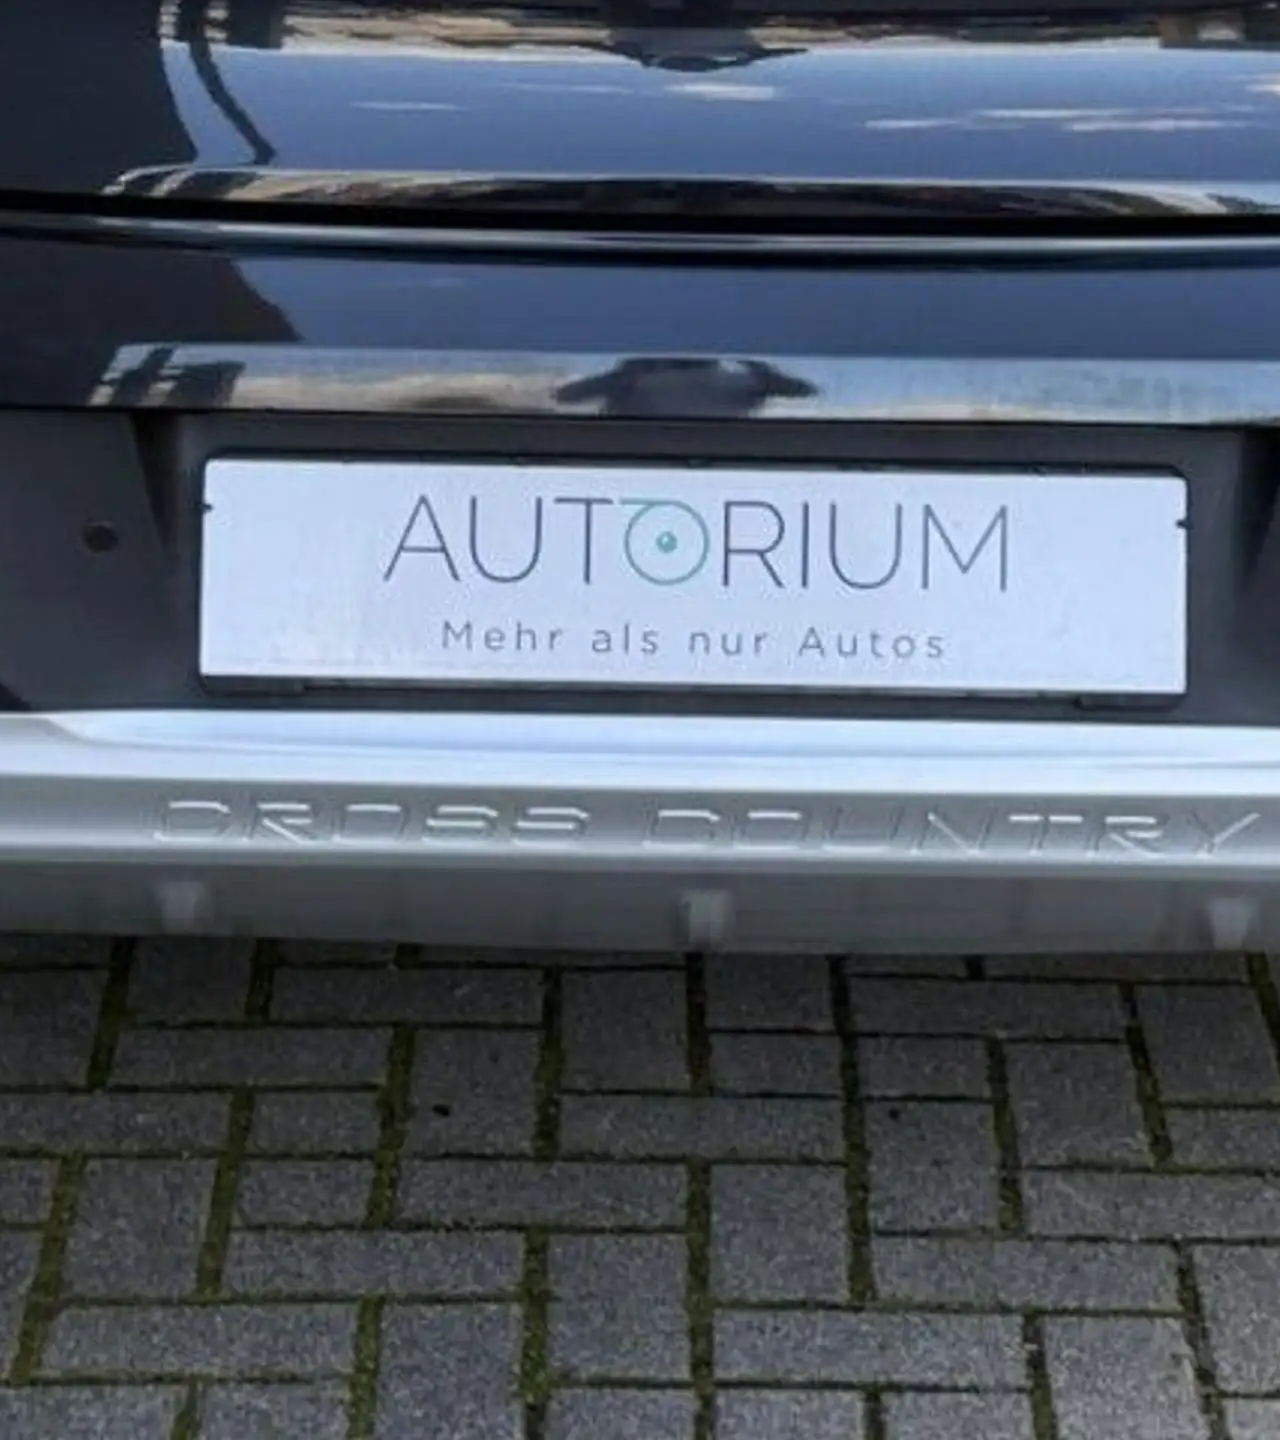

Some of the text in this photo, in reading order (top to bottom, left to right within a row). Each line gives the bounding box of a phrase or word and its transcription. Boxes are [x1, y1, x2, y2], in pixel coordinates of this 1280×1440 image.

[383, 493, 1009, 592] AUTORIUM
[440, 618, 948, 661] Mehr als nur Autos
[153, 799, 1262, 859] CROSS COUNTRY
